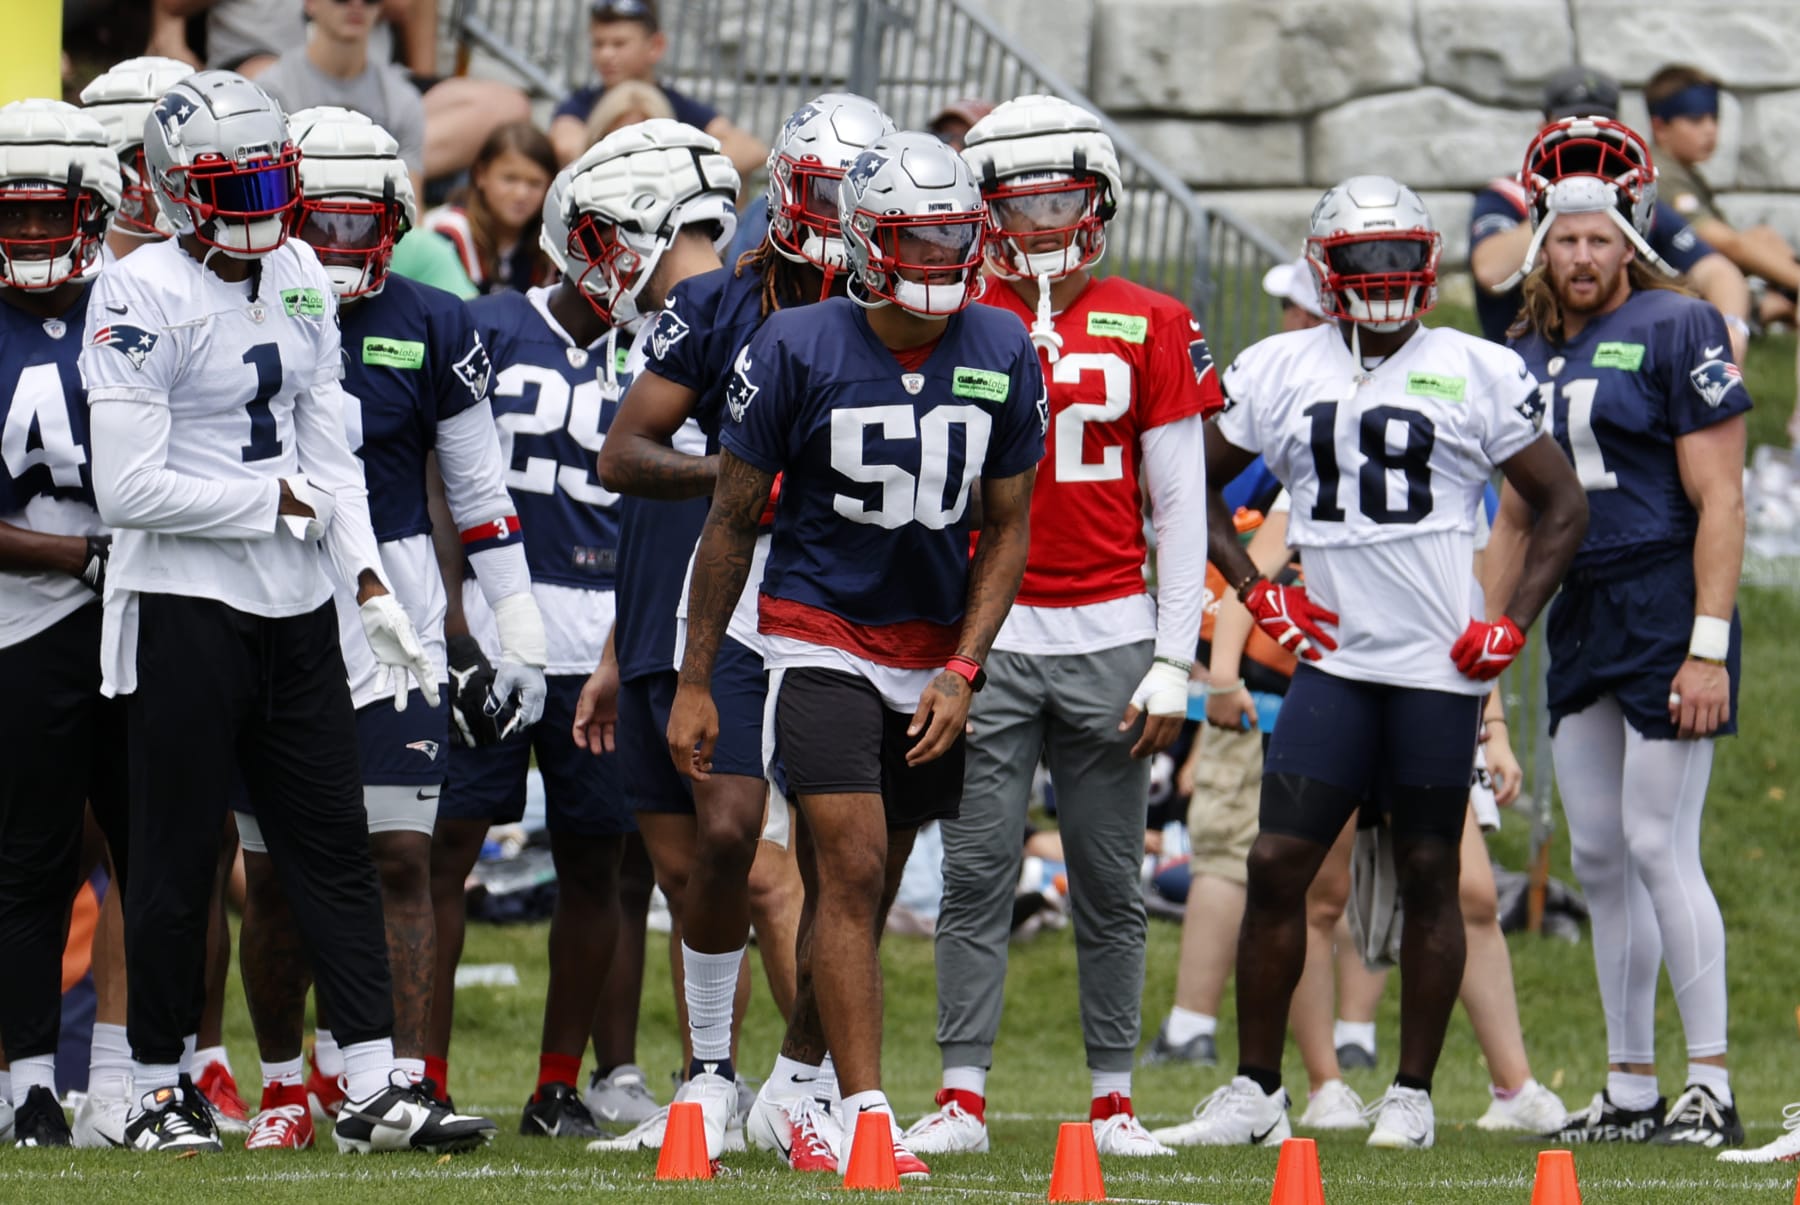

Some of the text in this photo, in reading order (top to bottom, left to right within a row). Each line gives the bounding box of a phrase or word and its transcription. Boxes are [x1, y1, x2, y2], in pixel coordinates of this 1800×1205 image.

[1, 362, 87, 488] 4
[241, 341, 283, 463] 1
[494, 363, 624, 508] 29
[1303, 401, 1435, 525] 18
[493, 516, 510, 540] 3
[830, 404, 993, 530] 50
